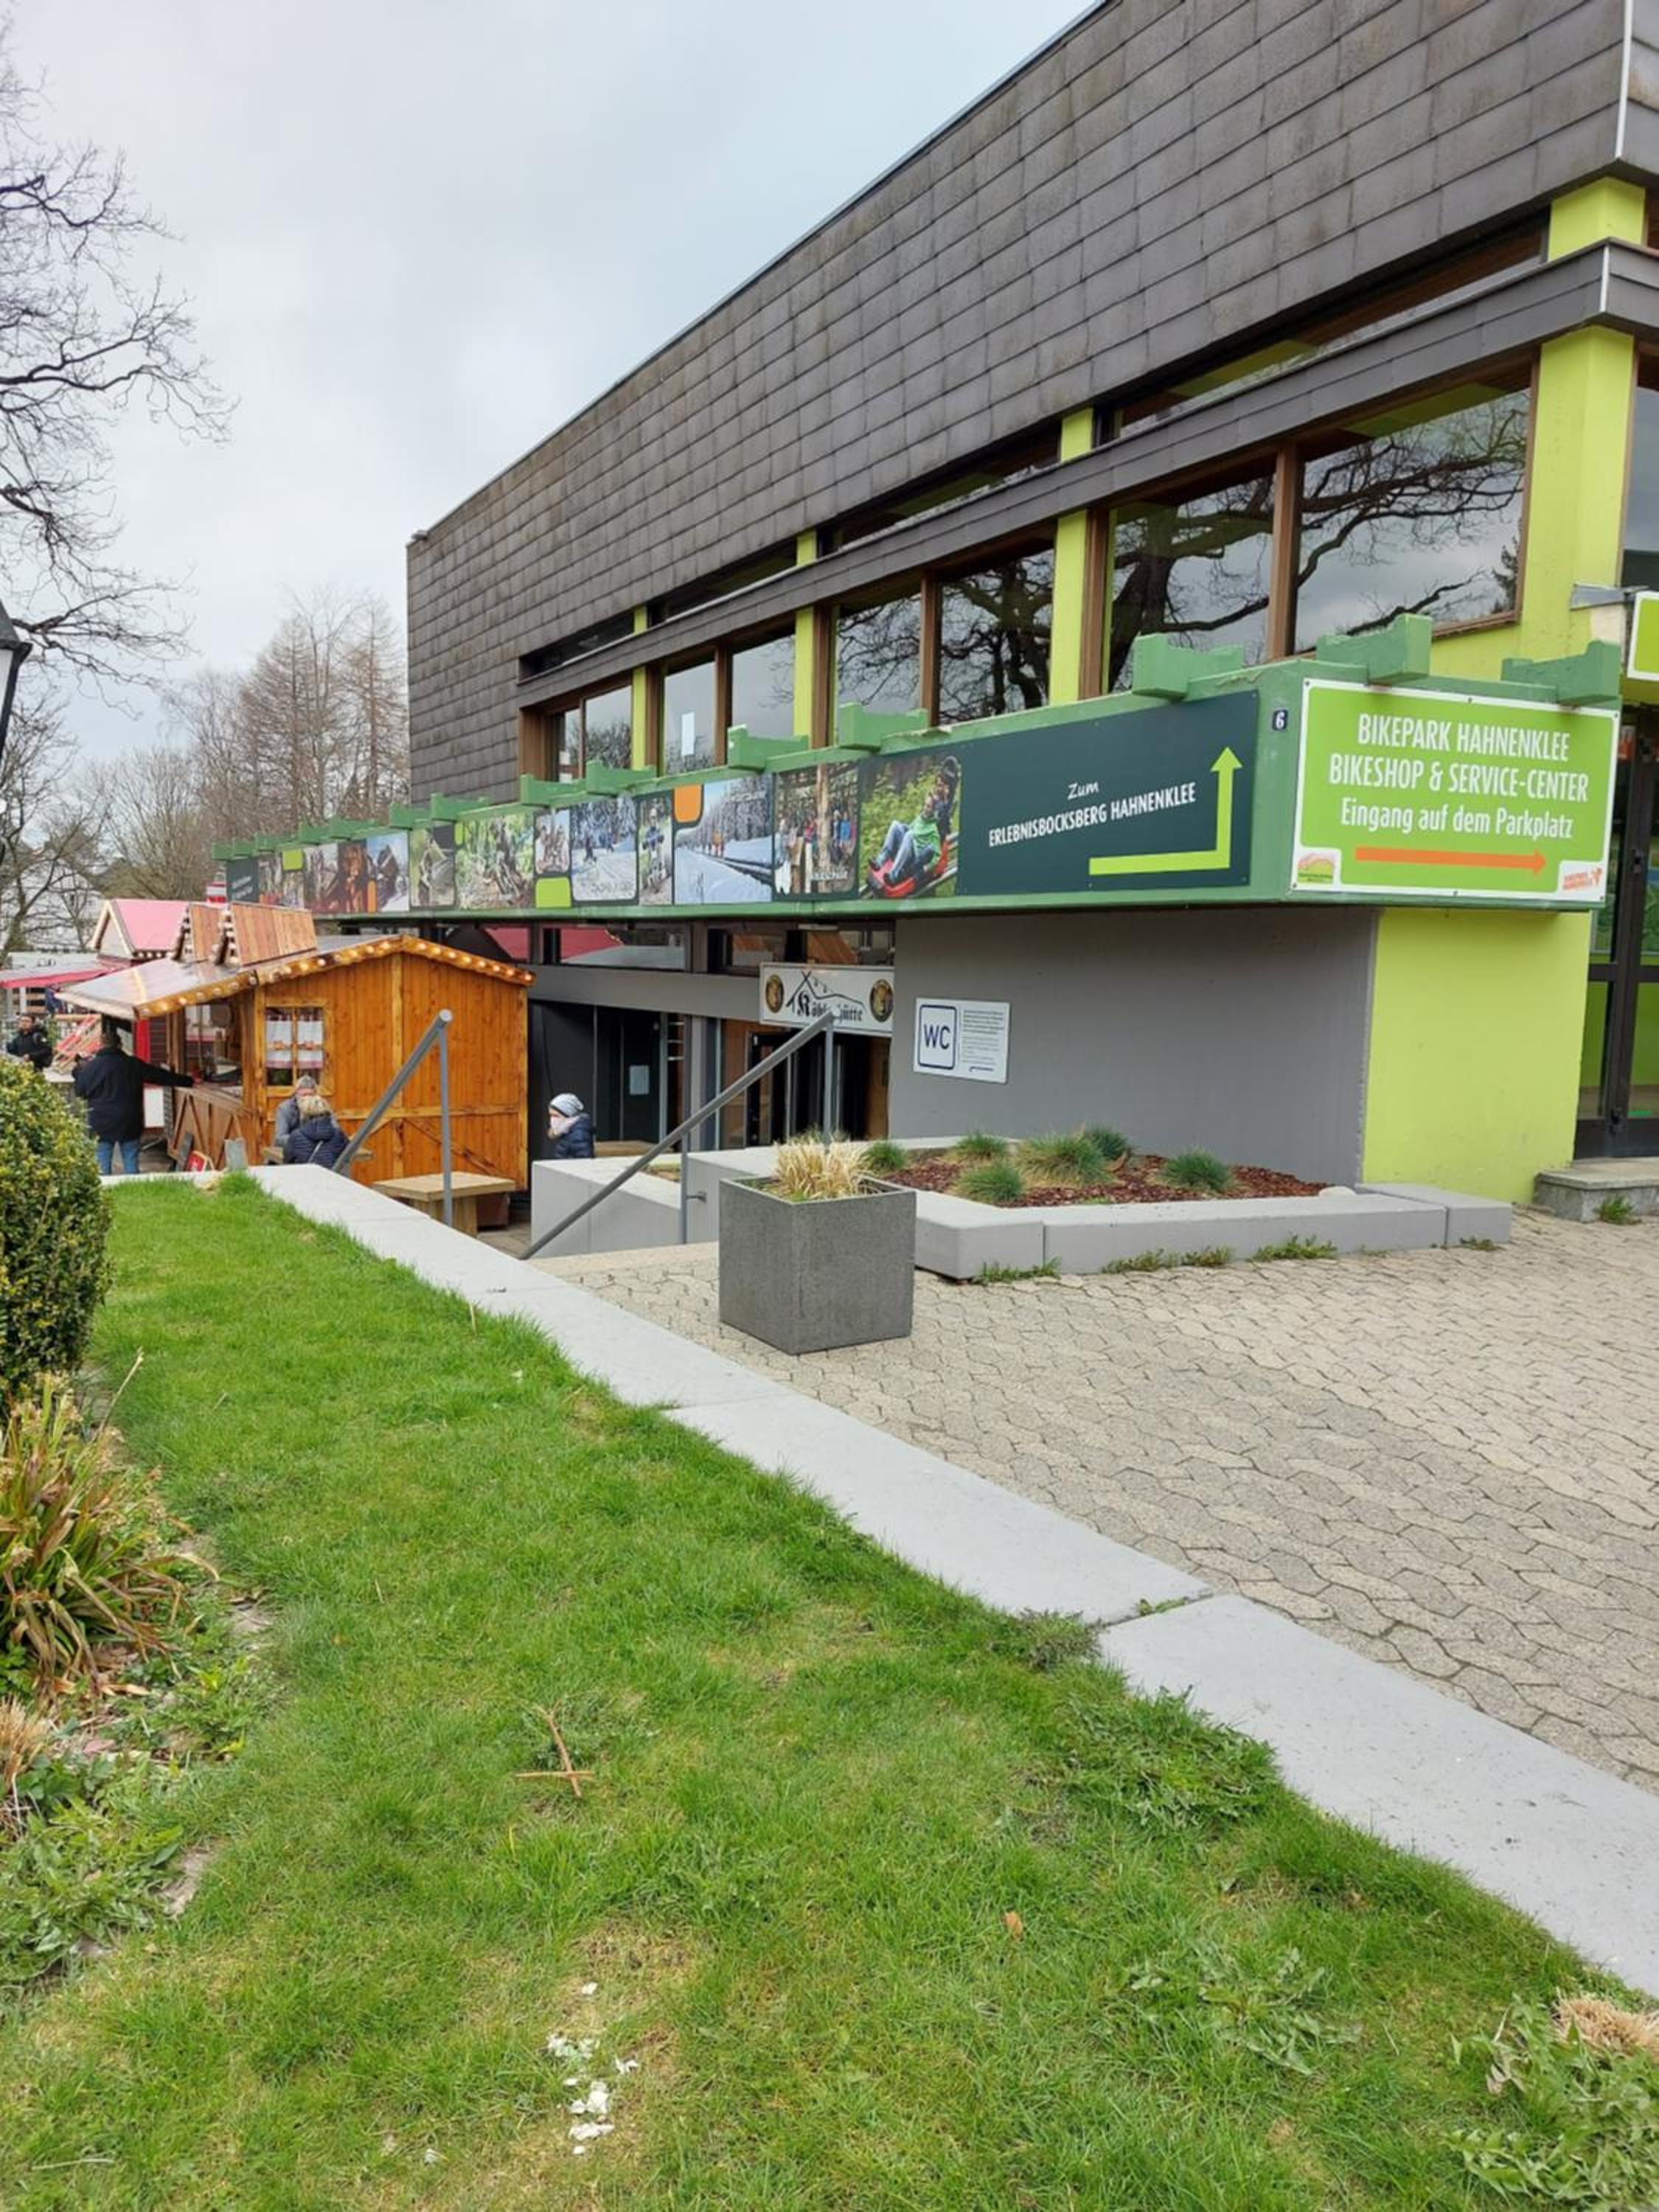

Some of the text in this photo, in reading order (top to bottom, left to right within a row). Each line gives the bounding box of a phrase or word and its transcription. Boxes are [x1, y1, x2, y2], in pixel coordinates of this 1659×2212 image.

[1276, 711, 1285, 729] 6
[1358, 713, 1570, 761] BIKEPARK HAHNENKLEE
[1068, 782, 1099, 800] Zum
[1329, 754, 1589, 802] BIKESHOP & SERVICE-CENTER
[989, 782, 1196, 847] ERLEBNISBOCKSBERG HAHNENKLEE
[1340, 798, 1573, 841] Eingang auf dem Parkplatz
[923, 1024, 950, 1050] WC
